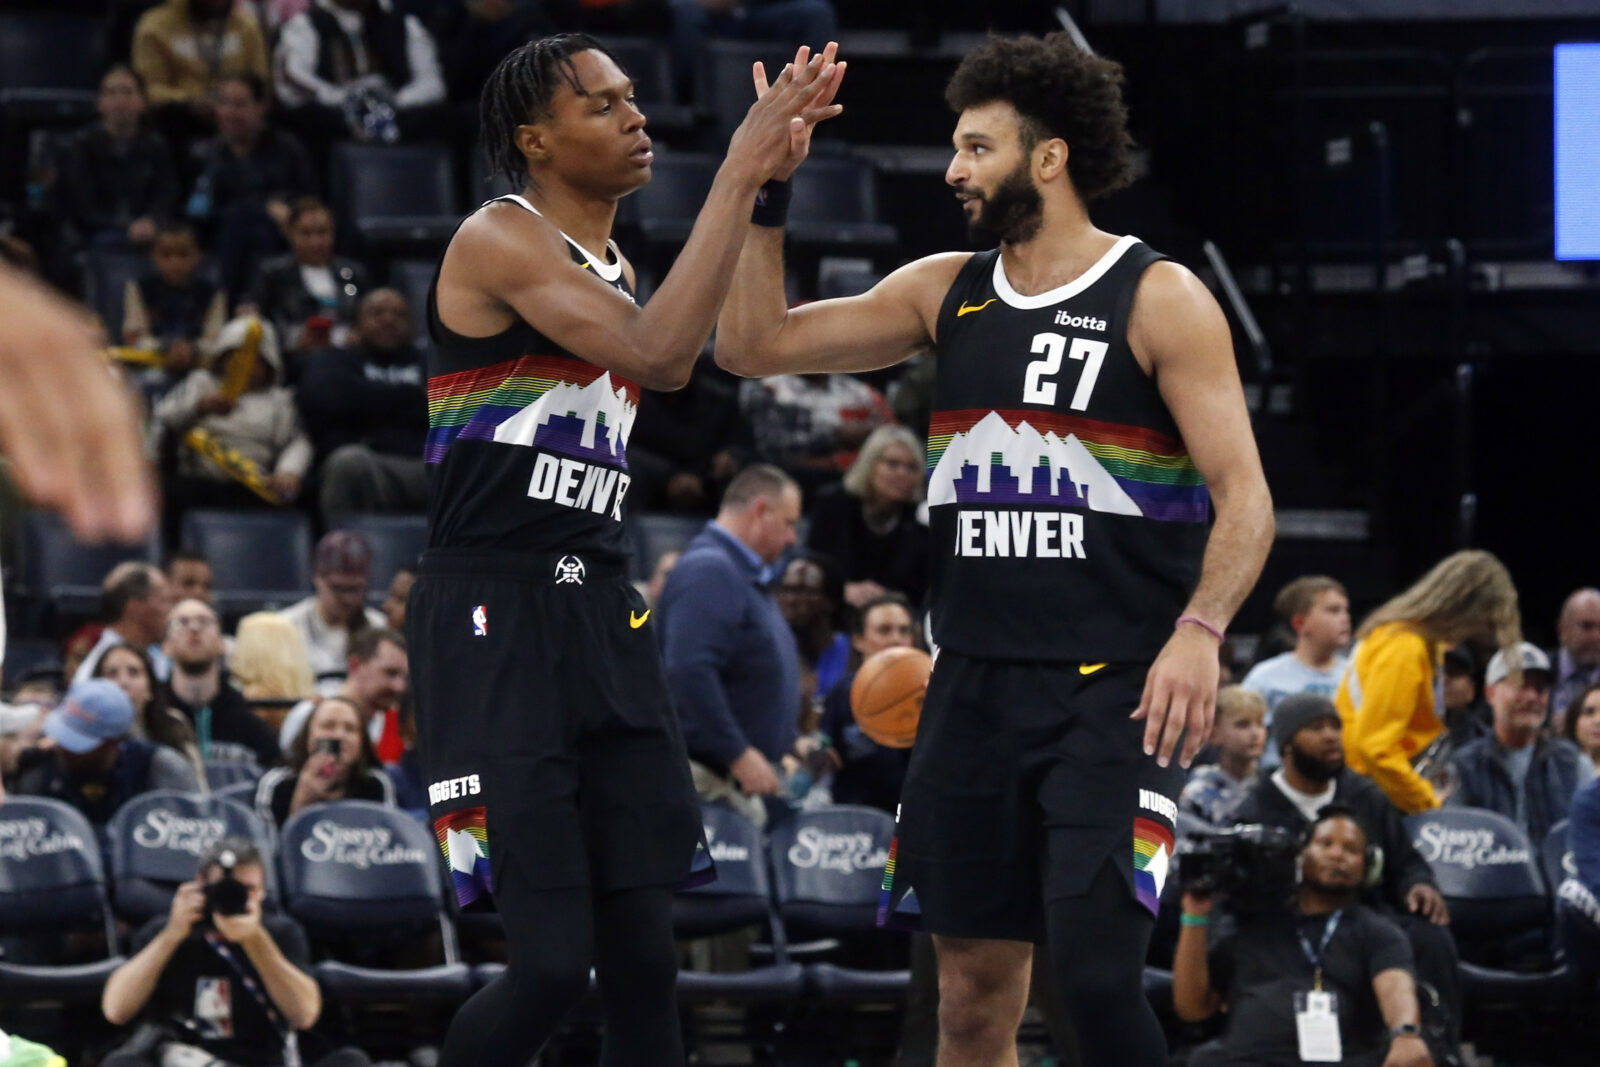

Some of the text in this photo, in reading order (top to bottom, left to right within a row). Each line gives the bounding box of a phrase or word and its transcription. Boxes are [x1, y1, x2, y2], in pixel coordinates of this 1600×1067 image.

[1054, 310, 1107, 331] ibotta
[1023, 332, 1109, 411] 27
[955, 511, 1087, 559] ENVER
